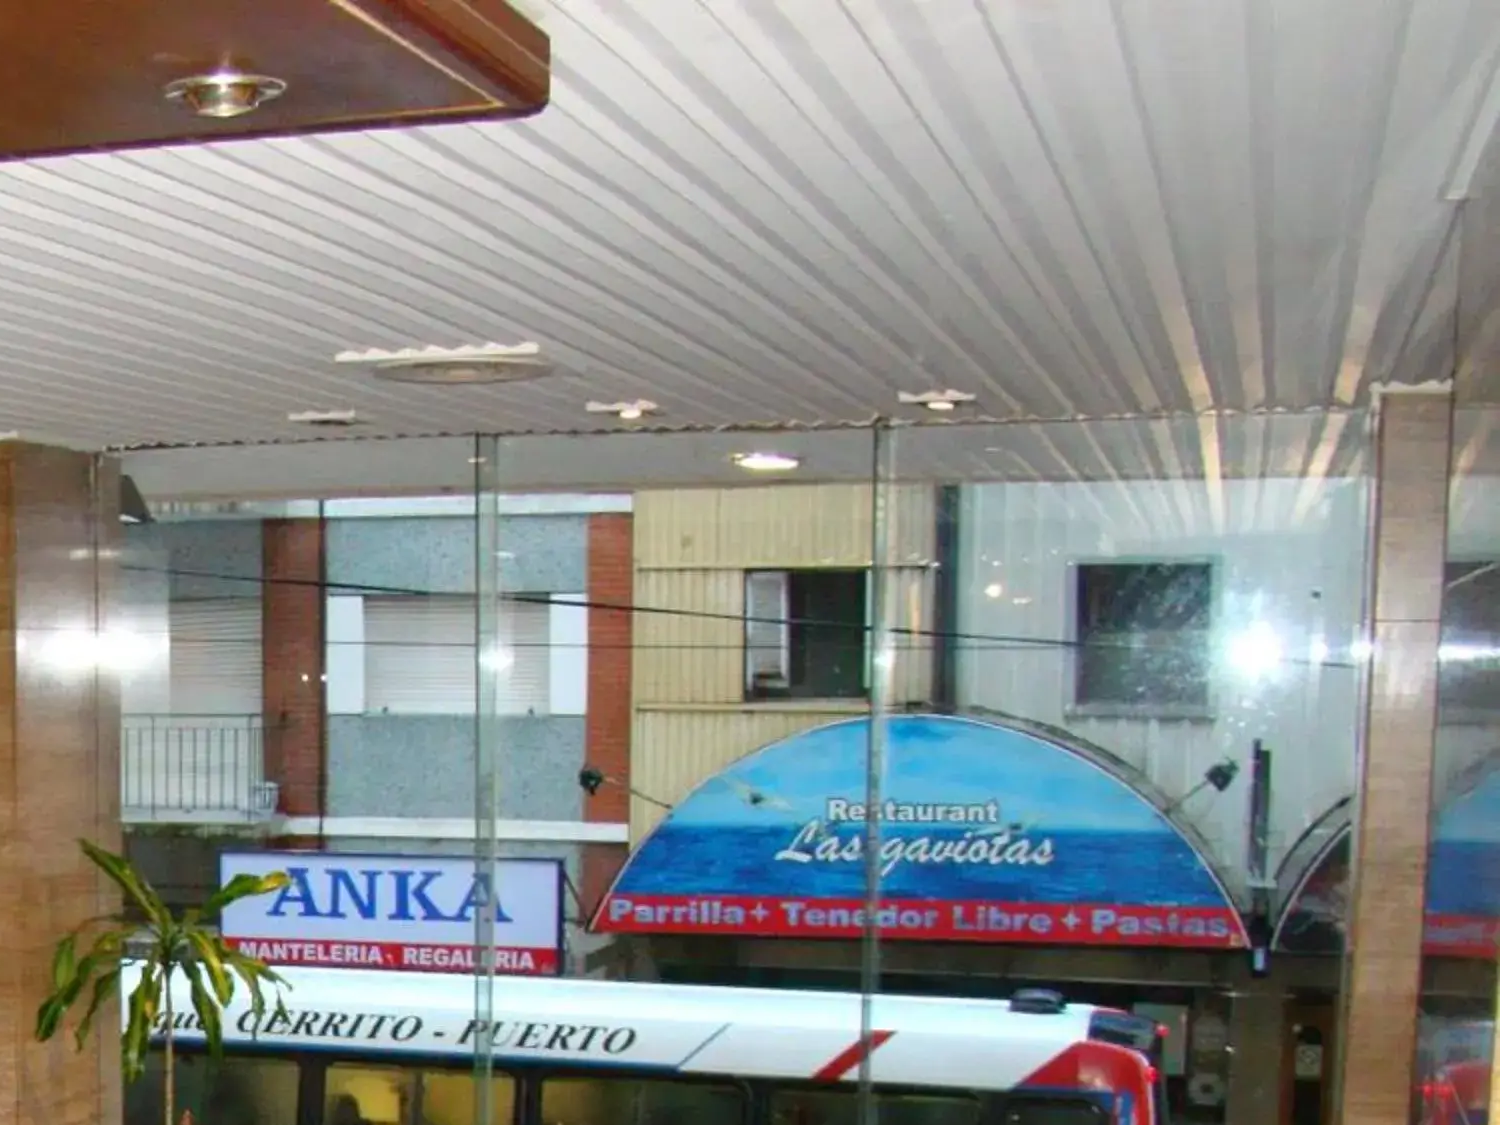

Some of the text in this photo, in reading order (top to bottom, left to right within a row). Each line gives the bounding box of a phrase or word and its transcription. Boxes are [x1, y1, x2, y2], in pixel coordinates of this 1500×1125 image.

[827, 798, 998, 823] Retaurant
[775, 819, 1054, 877] Las gaviotas
[266, 867, 514, 923] ANKA
[609, 898, 745, 925] Parrilla
[780, 901, 939, 930] Tenedor
[952, 904, 1054, 932] Libre
[1091, 908, 1229, 938] Pastas
[238, 941, 384, 964] MANTELERIA
[456, 1018, 637, 1055] PUERTO
